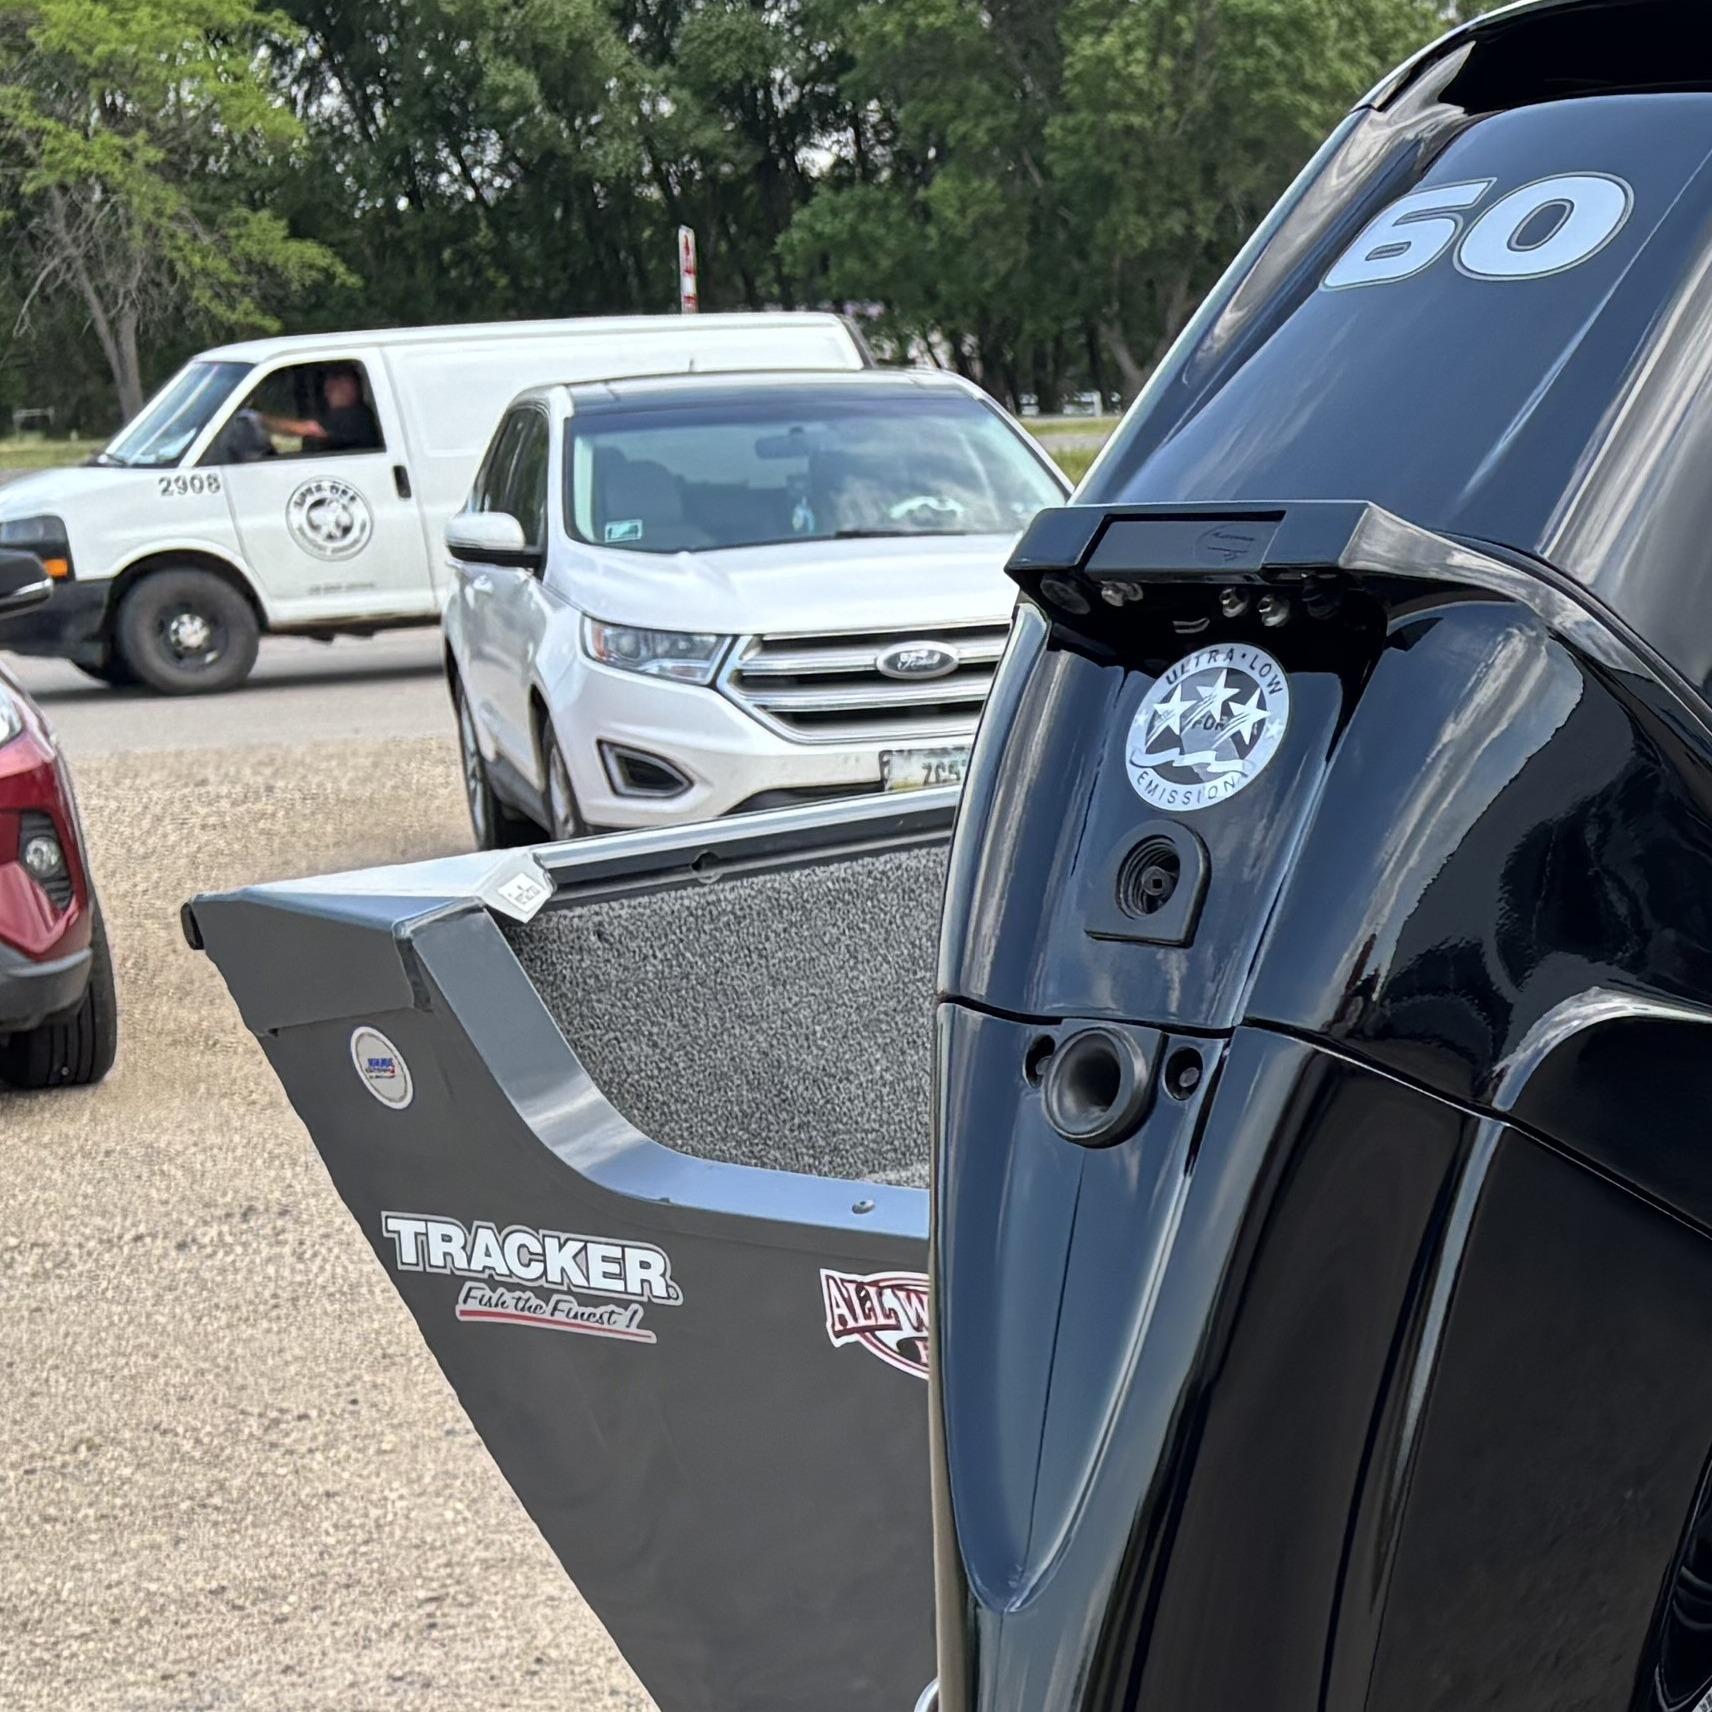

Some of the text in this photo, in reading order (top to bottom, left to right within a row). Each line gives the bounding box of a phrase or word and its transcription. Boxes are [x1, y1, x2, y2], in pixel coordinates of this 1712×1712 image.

[1319, 171, 1634, 292] 60
[1165, 648, 1283, 696] ULTRA LOW
[462, 1287, 508, 1310] Fish
[512, 1289, 546, 1315] the
